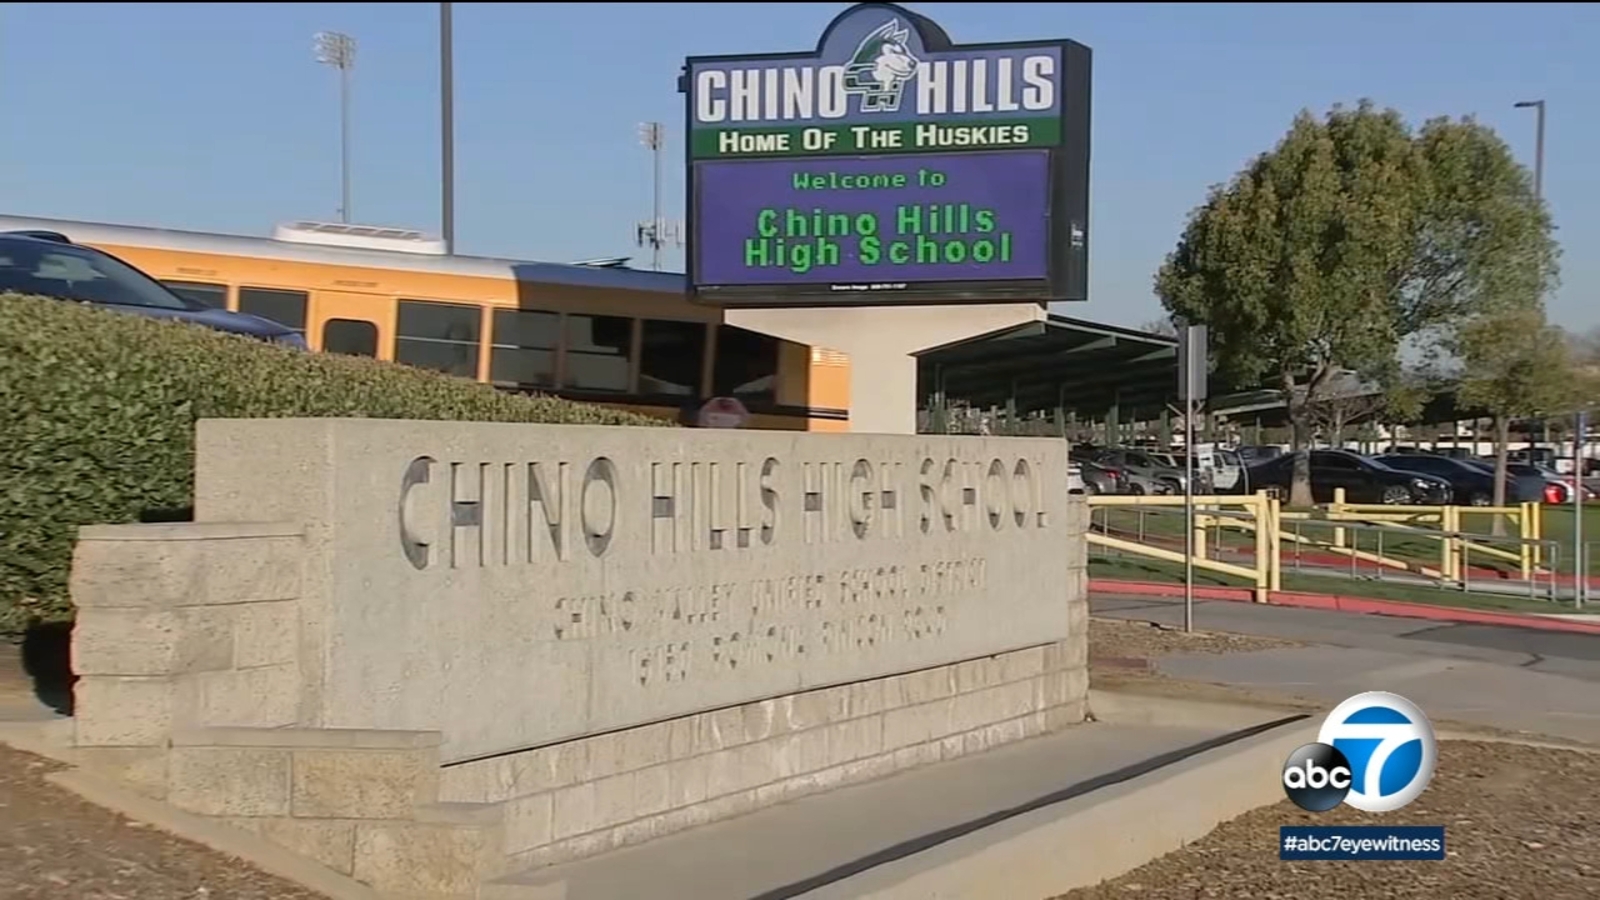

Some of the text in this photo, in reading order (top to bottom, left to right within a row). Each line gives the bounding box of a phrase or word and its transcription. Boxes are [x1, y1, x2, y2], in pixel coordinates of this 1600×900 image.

[697, 55, 1055, 123] CHINO HILLS
[792, 169, 947, 190] Welcome to
[757, 205, 995, 238] Chino Hills
[744, 233, 1012, 273] High School
[400, 455, 1047, 570] CHINO HILLS HIGH SCHOOL
